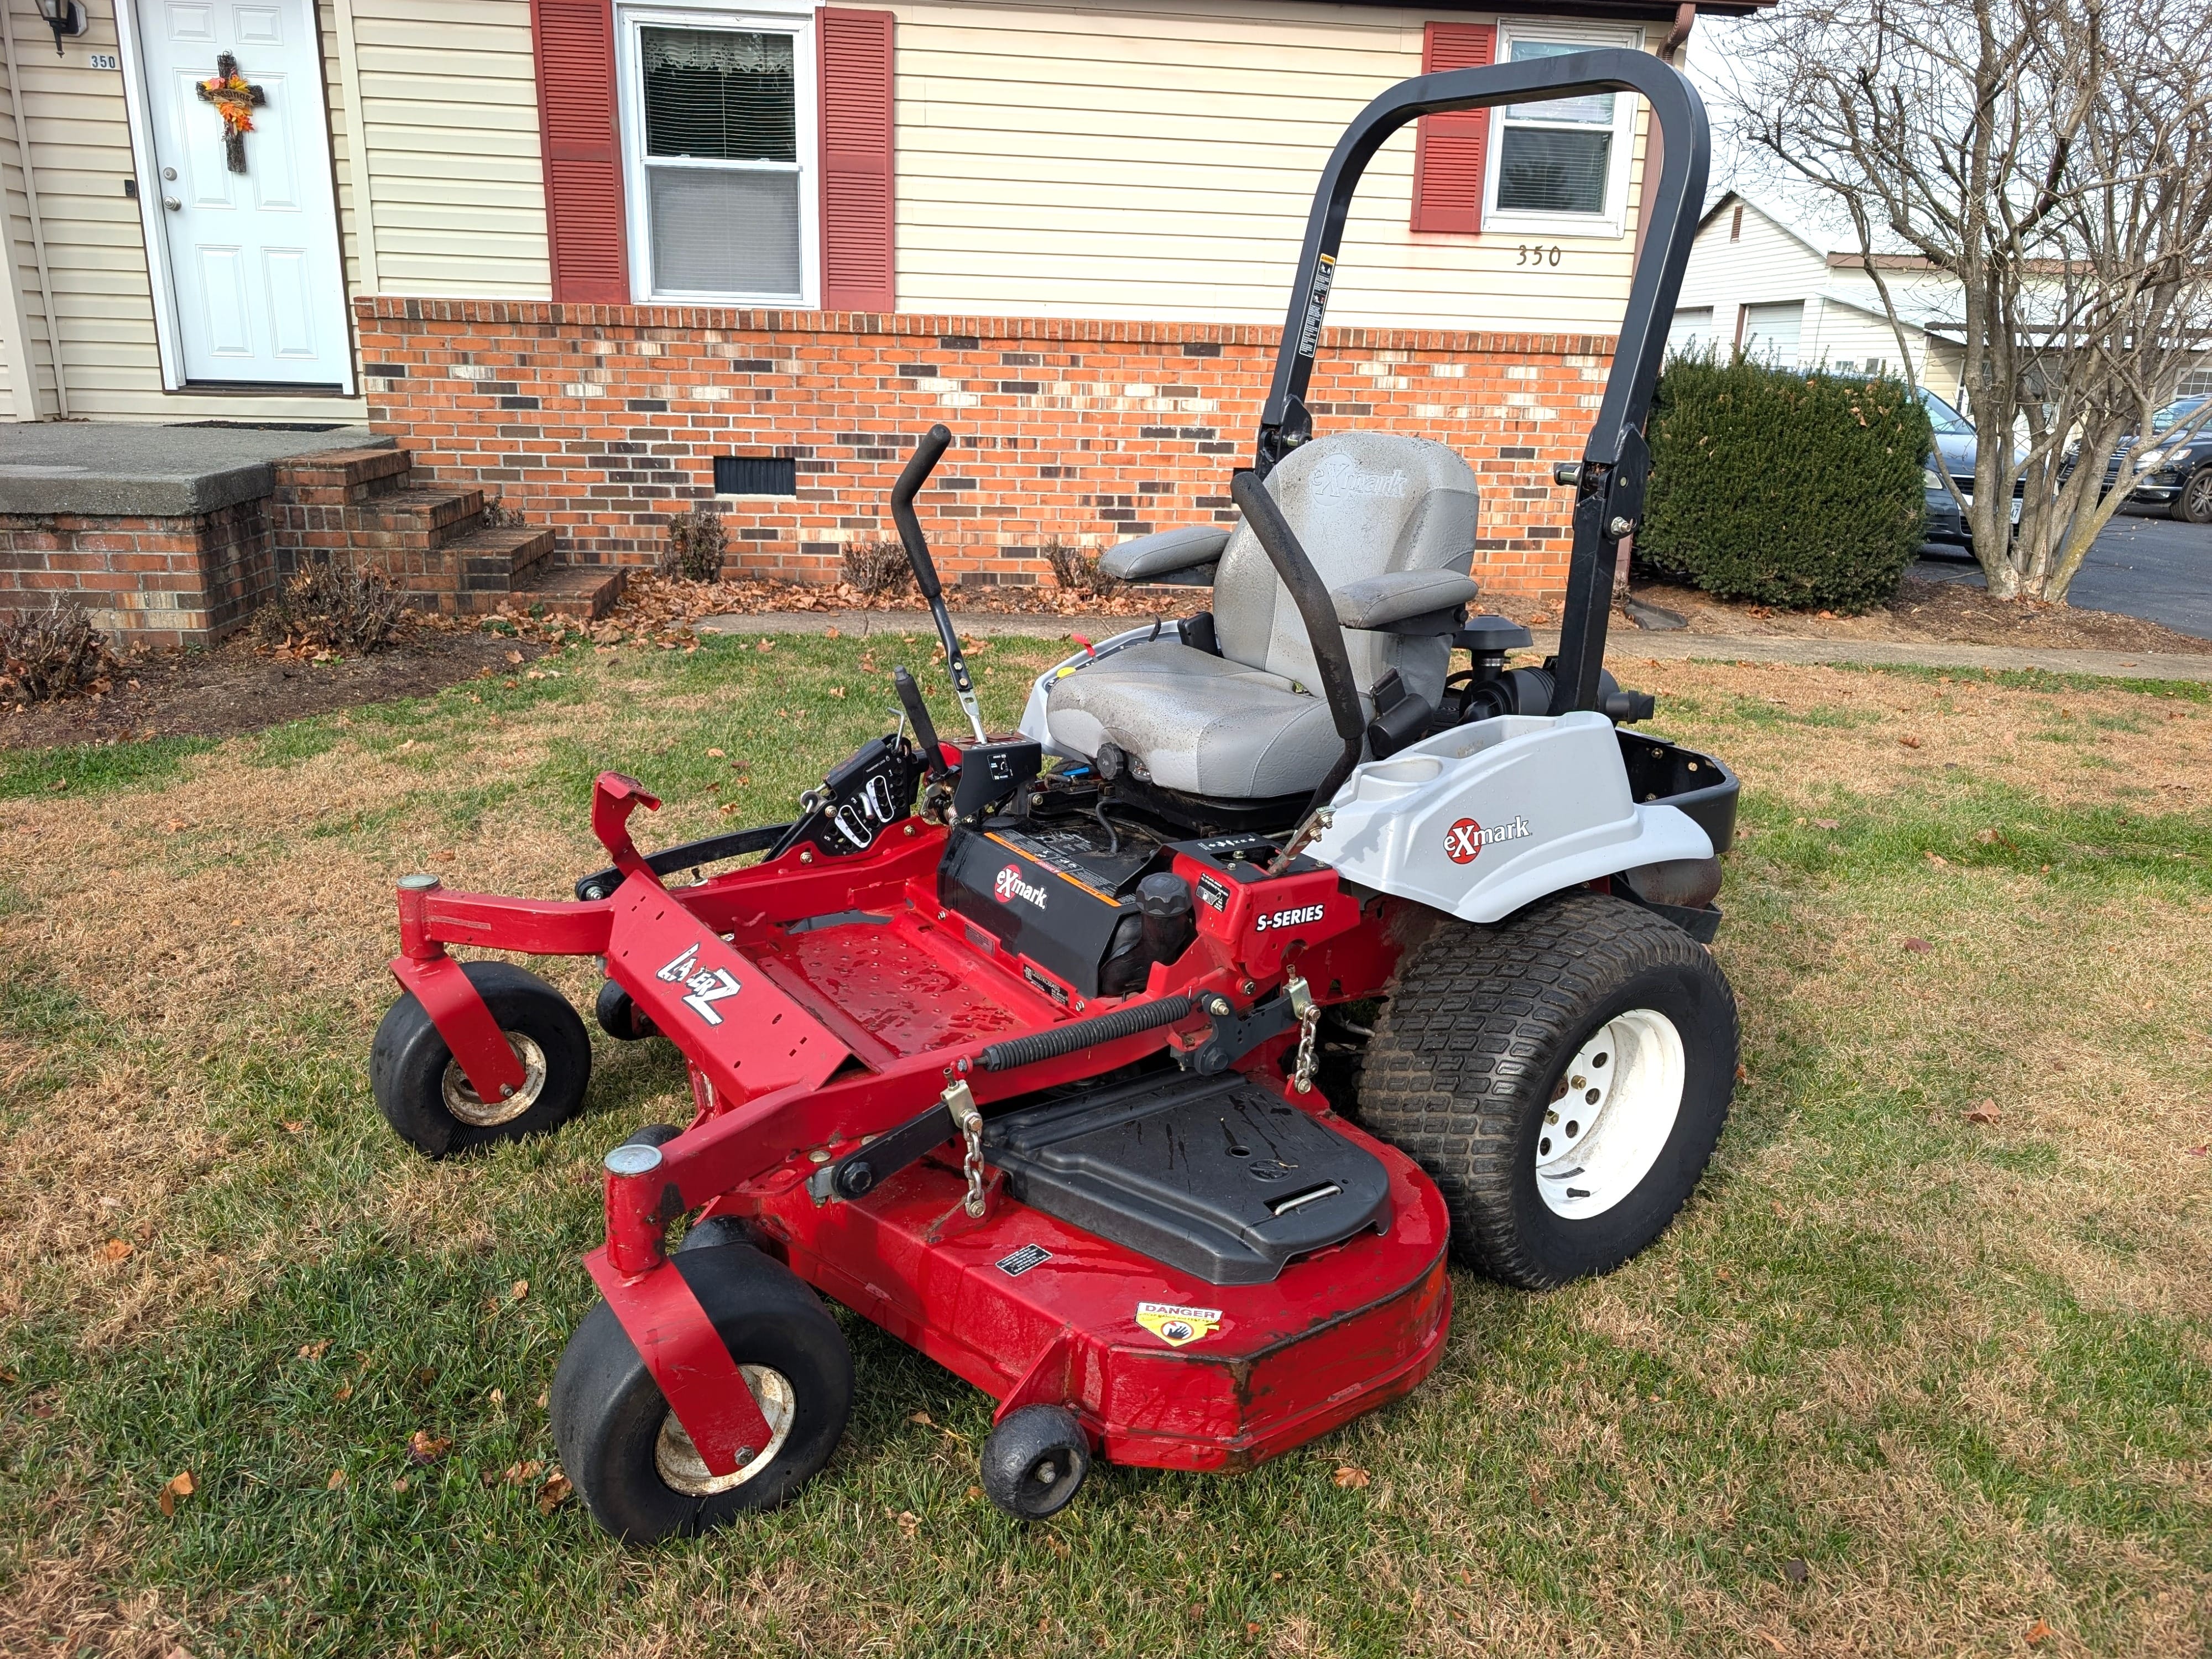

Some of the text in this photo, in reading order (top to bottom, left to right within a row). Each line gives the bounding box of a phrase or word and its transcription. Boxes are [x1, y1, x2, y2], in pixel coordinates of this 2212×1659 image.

[91, 55, 116, 69] 350
[208, 90, 251, 102] Bessings
[1516, 244, 1561, 267] 350
[888, 769, 894, 777] 1
[1443, 815, 1530, 858] eXmark
[996, 868, 1047, 909] eXmark
[1256, 905, 1324, 931] S-SERIES
[1145, 1305, 1215, 1319] DANGER
